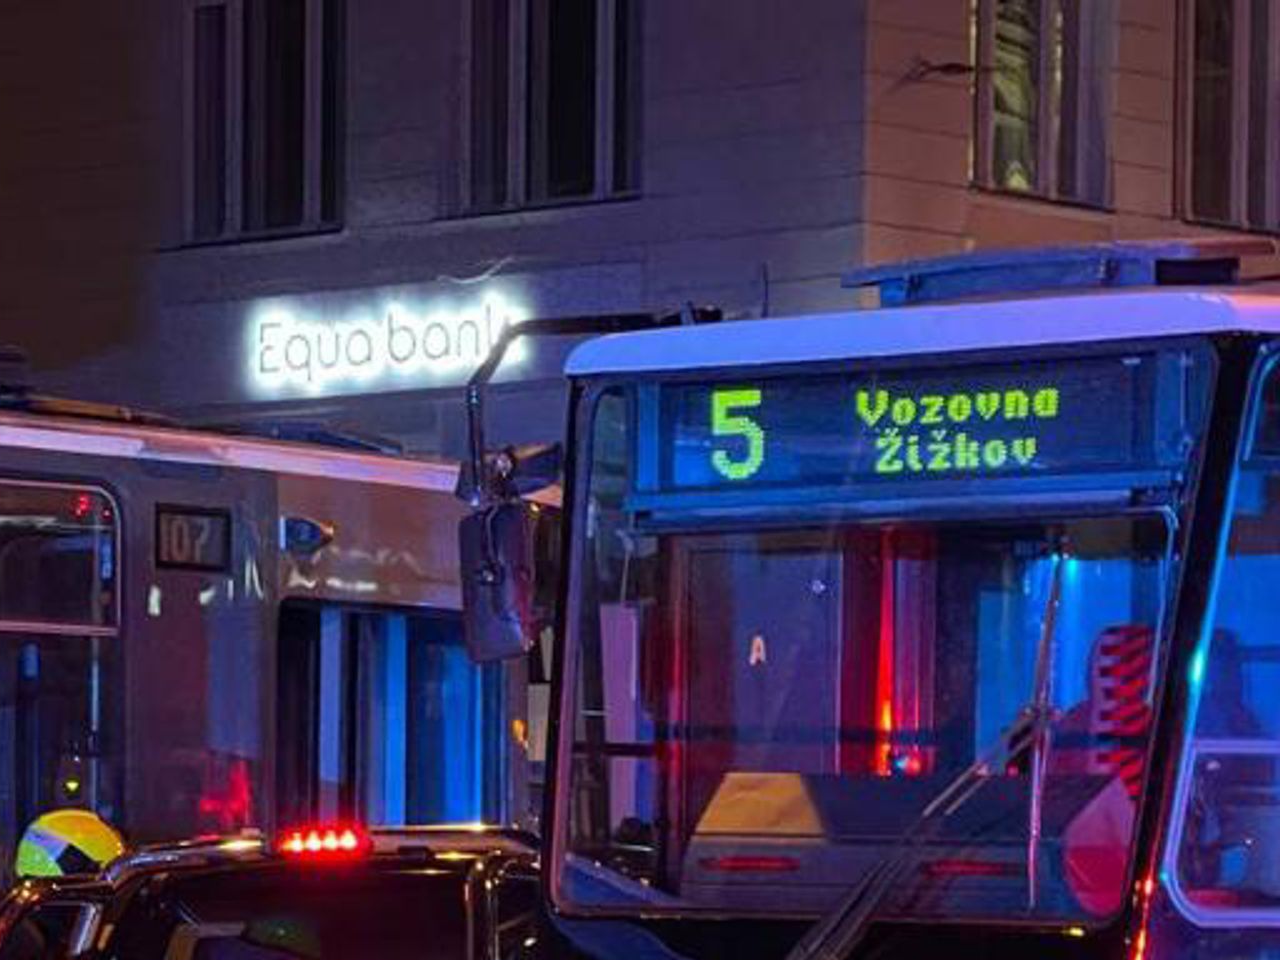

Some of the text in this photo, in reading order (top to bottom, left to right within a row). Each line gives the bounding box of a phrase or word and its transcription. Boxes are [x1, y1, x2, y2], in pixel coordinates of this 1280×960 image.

[259, 322, 372, 382] Equa
[855, 387, 1059, 427] Vozovna
[711, 389, 764, 480] 5
[874, 426, 1037, 473] Žižkov
